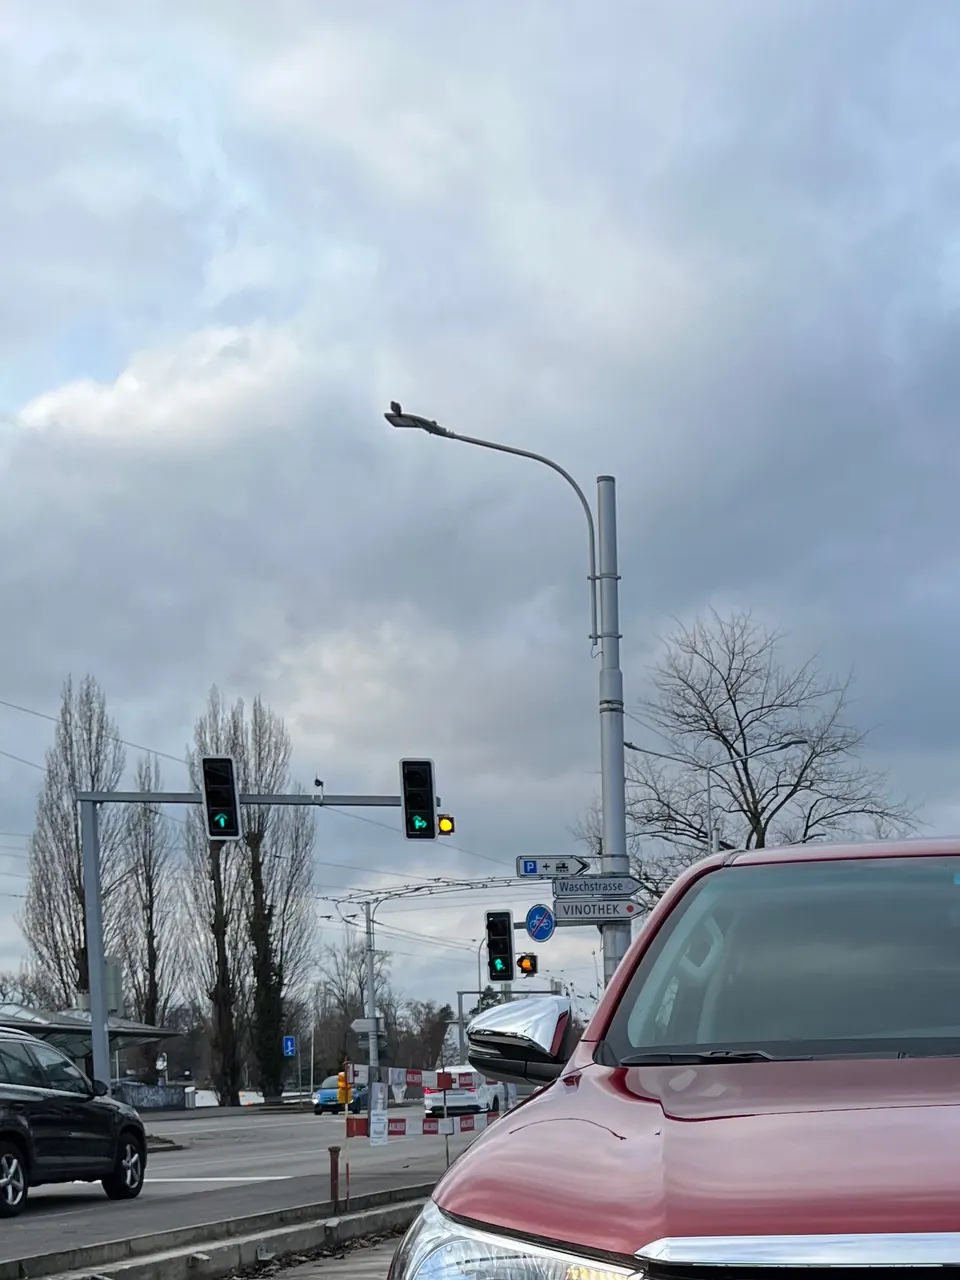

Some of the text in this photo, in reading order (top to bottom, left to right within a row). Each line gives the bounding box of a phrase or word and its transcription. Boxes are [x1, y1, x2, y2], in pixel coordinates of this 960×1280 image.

[526, 862, 534, 872] P
[559, 880, 623, 892] Waschstrasse
[562, 903, 620, 916] VINOTHEK
